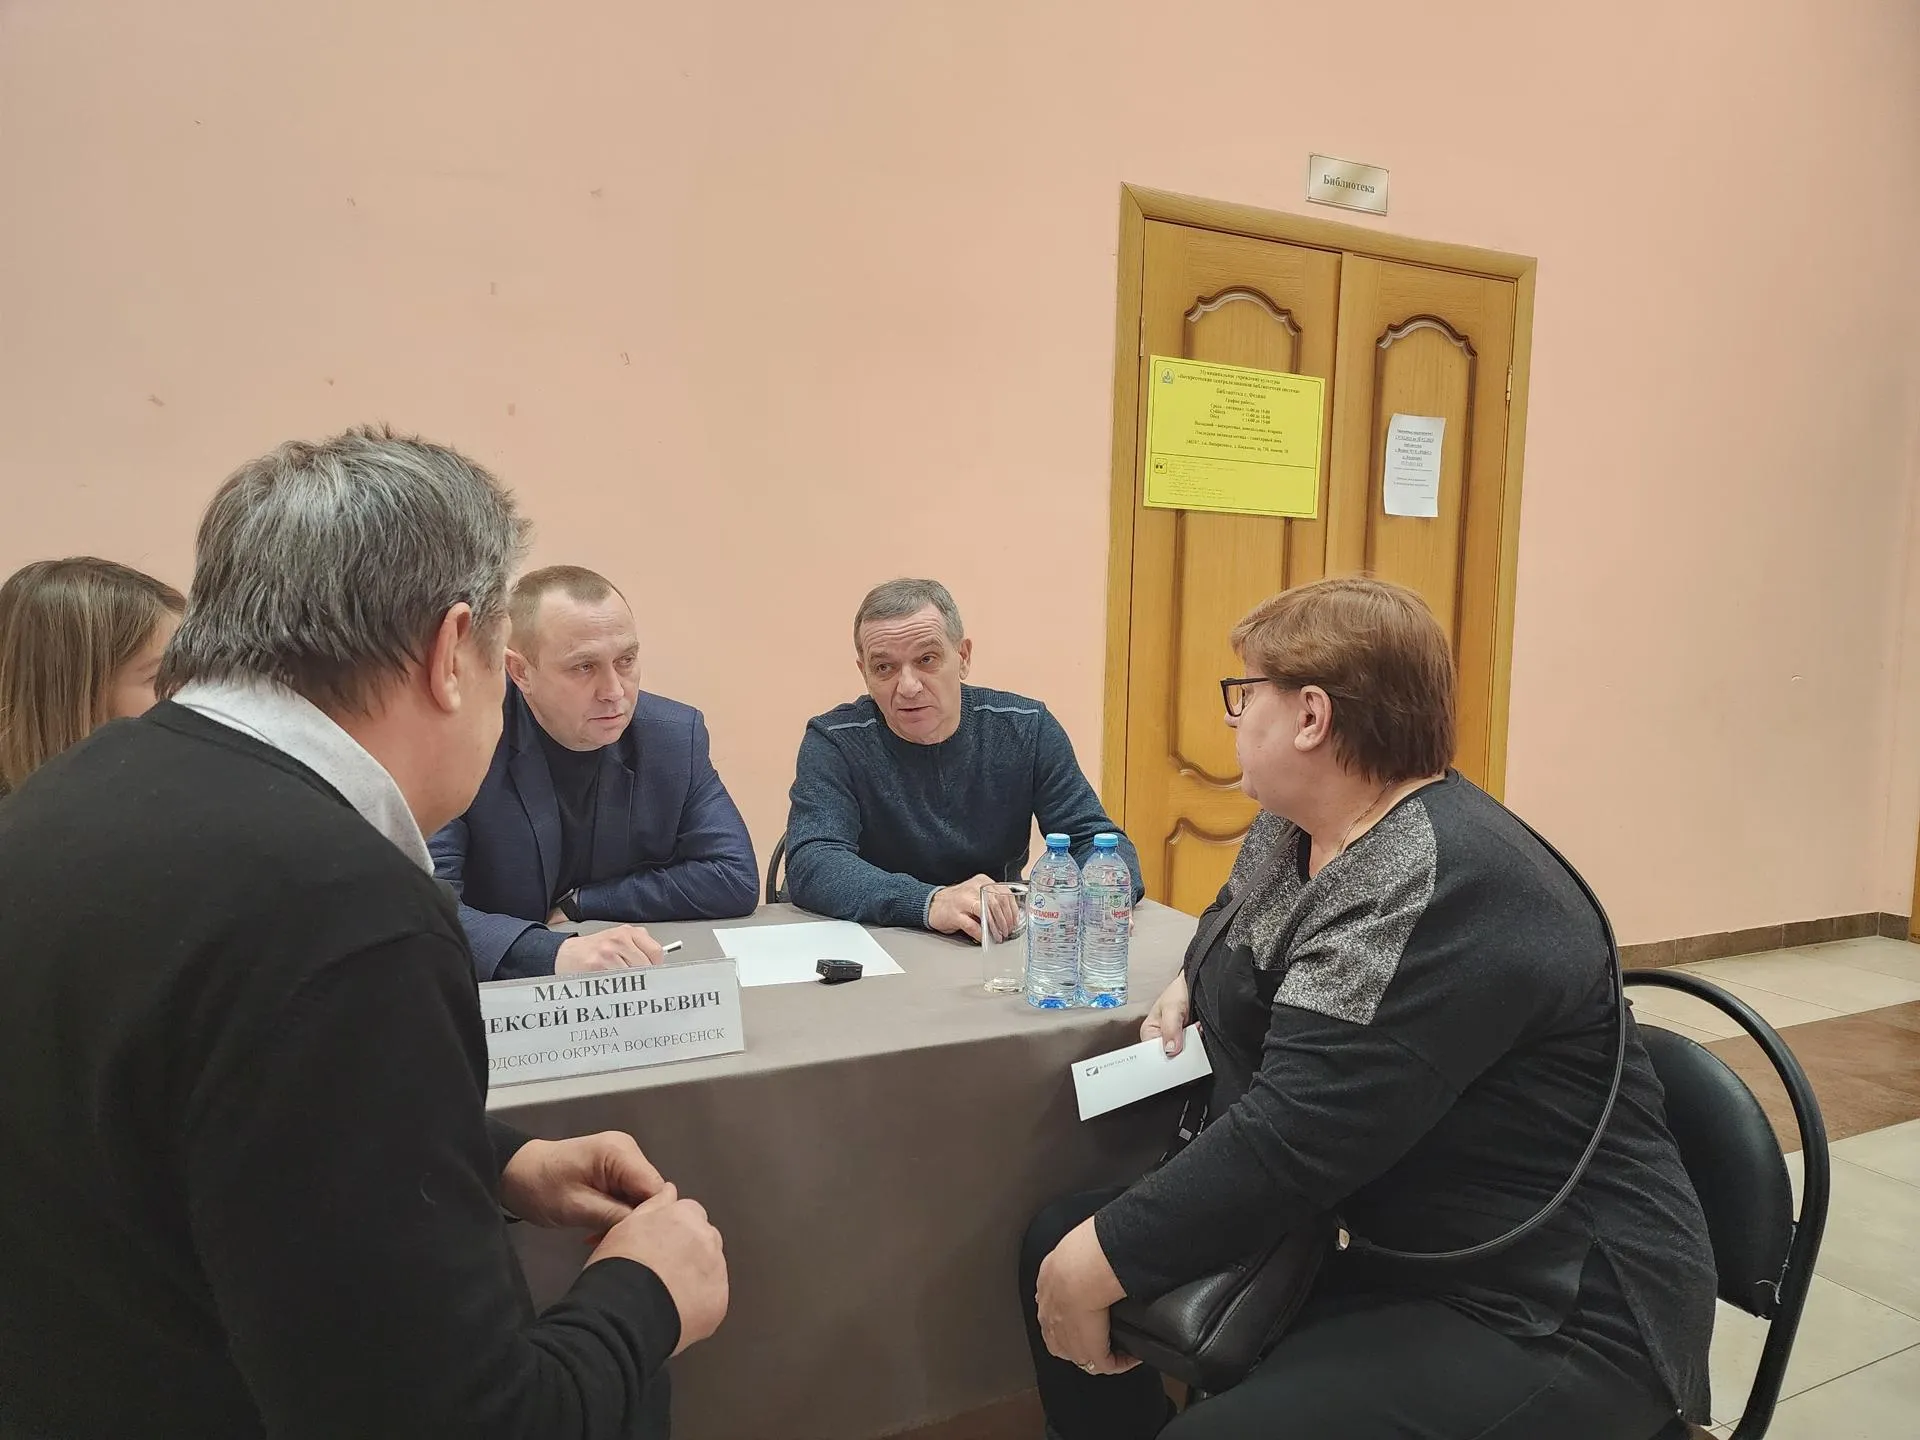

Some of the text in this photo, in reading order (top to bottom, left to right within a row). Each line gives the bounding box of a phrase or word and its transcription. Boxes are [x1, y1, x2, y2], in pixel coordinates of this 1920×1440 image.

[1323, 174, 1376, 194] Библиотека
[534, 974, 646, 1003] МАЛКИН
[486, 991, 720, 1035] ЕКСЕЙ ВАЛЕРЬЕВИЧ
[569, 1025, 619, 1042] ГЛАВА
[488, 1027, 726, 1072] ОДСКОГО ОКРУГА ВОСКРЕСЕНСК
